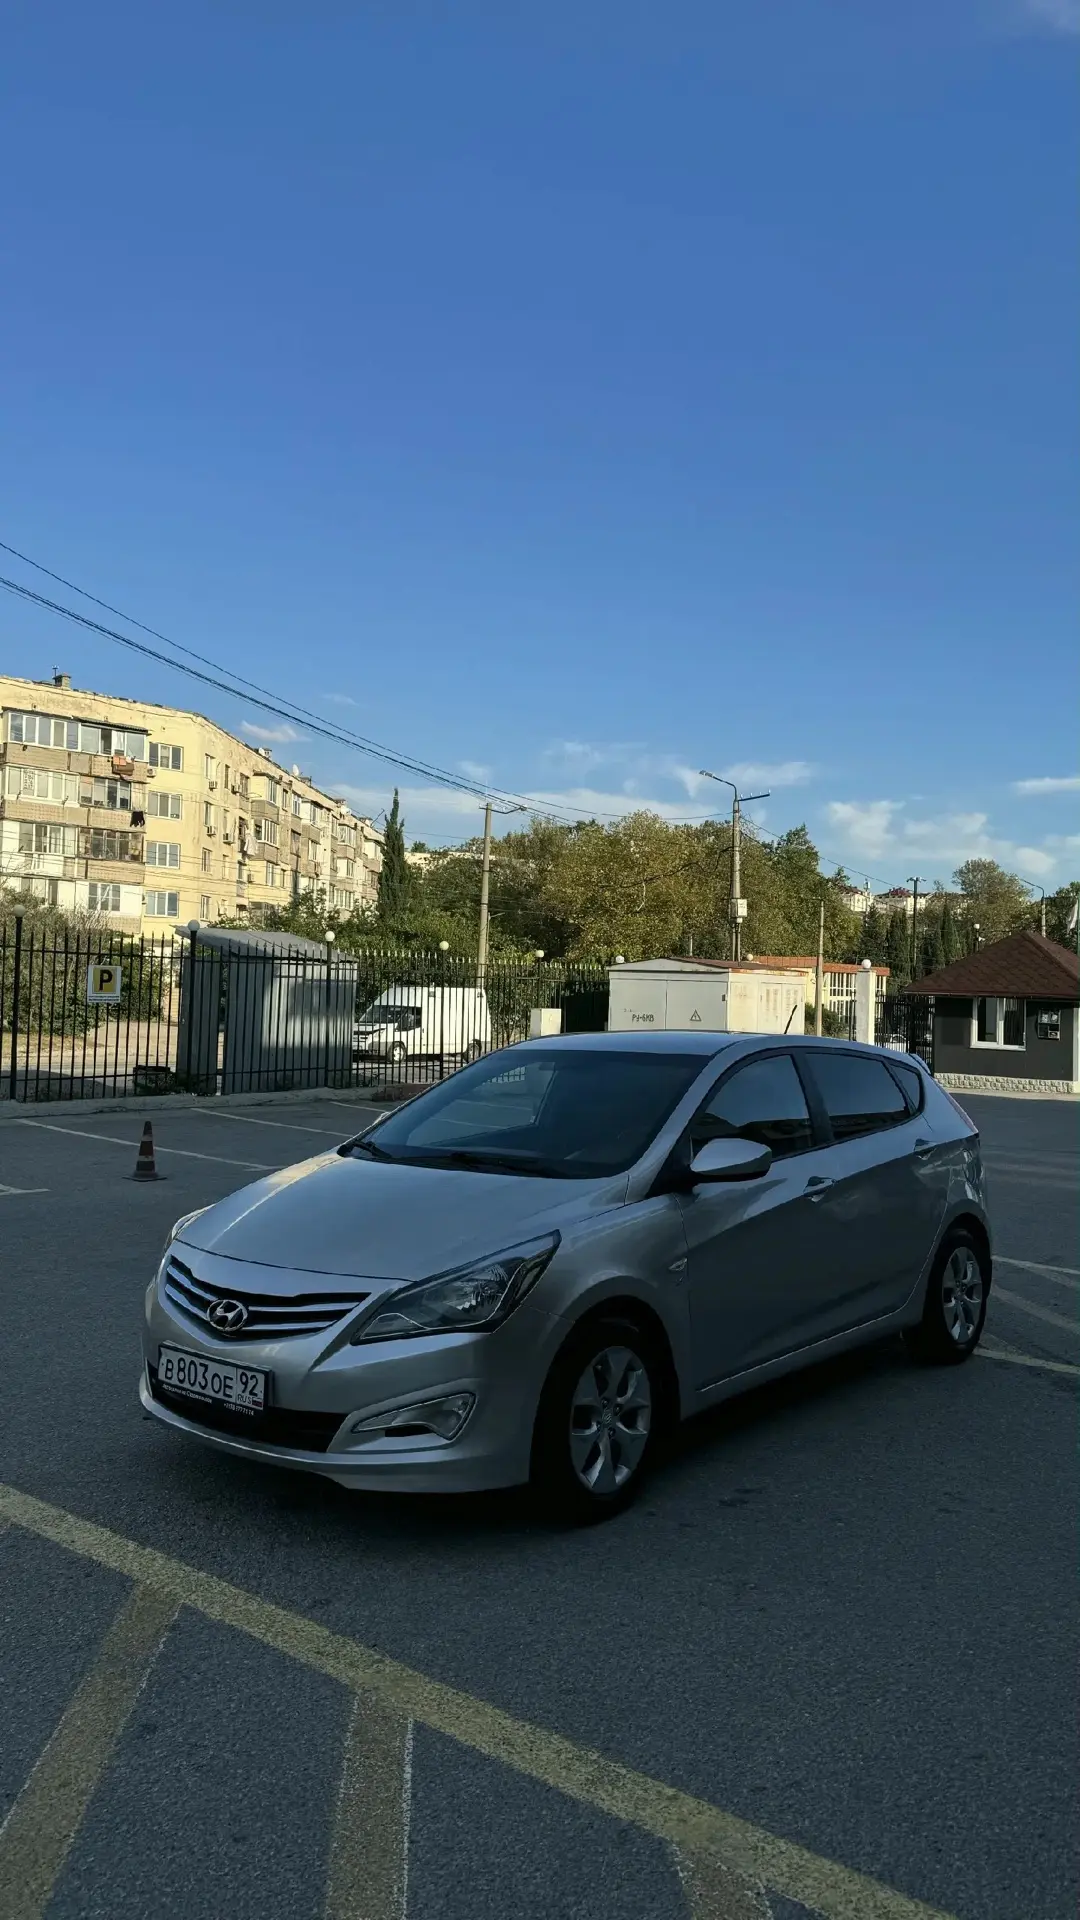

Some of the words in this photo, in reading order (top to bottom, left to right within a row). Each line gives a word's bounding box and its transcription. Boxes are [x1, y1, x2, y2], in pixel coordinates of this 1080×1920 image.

[99, 969, 113, 991] P
[240, 1371, 259, 1397] 92
[237, 1394, 252, 1405] RUS
